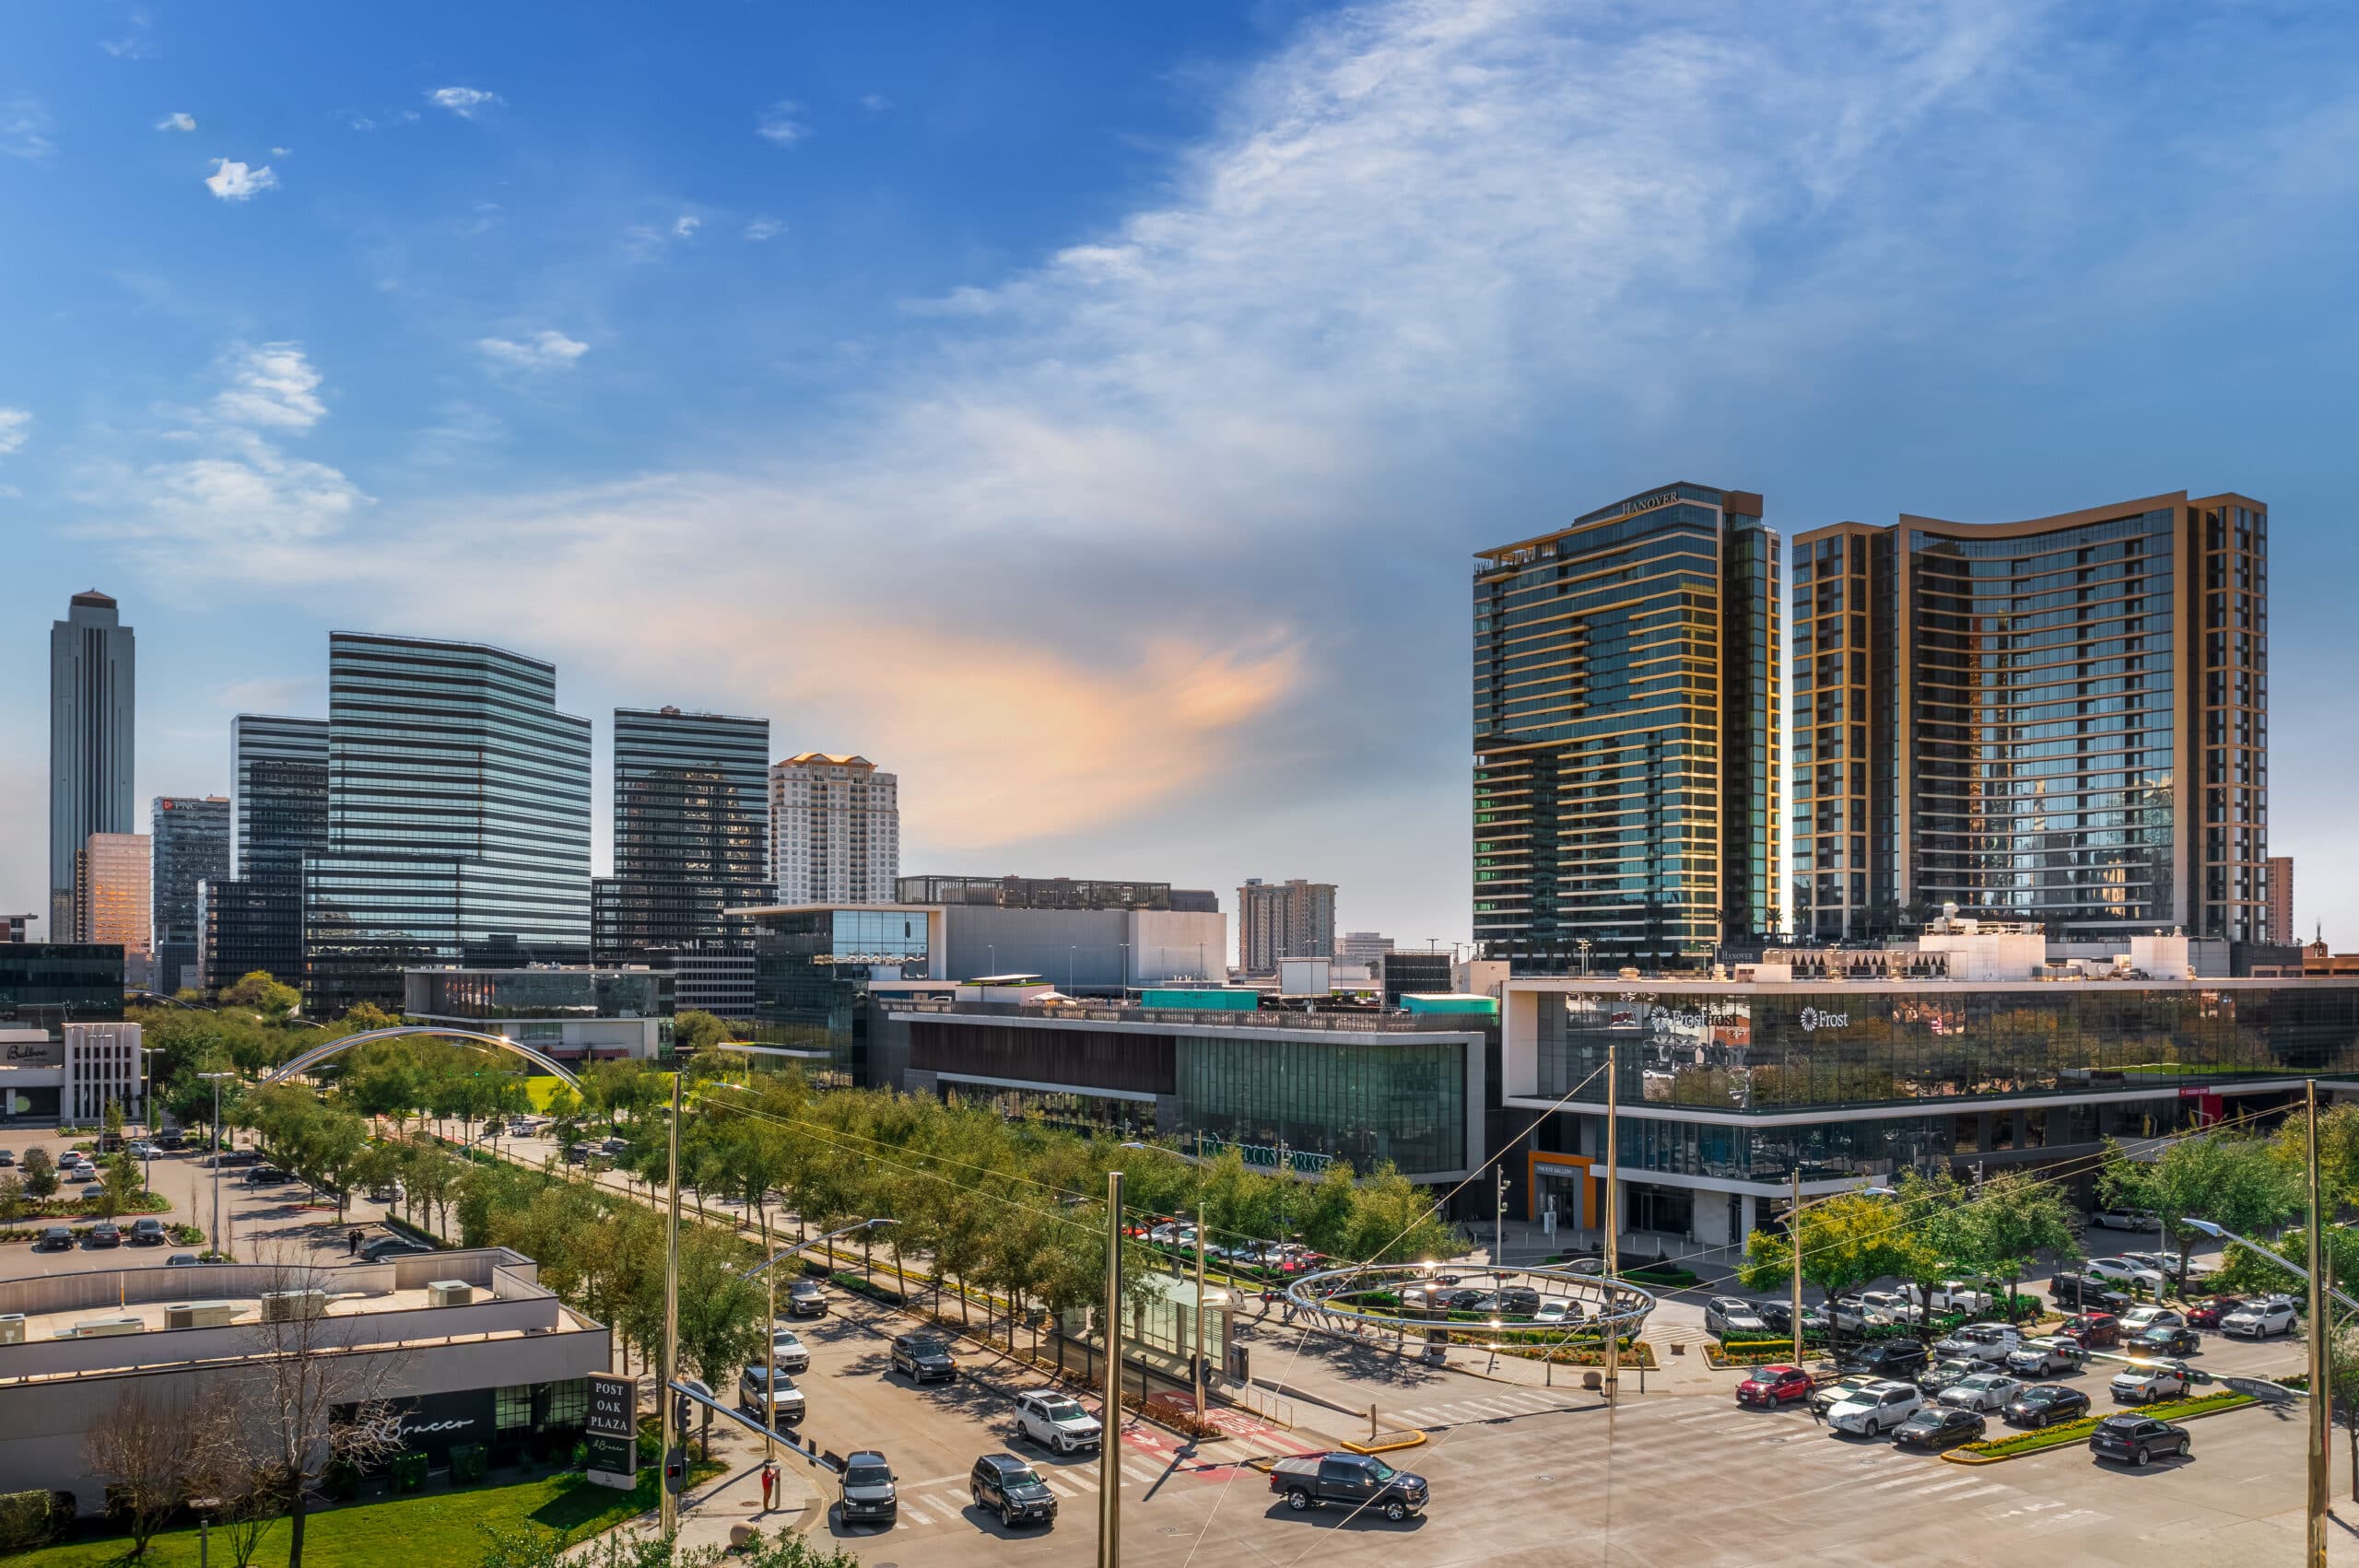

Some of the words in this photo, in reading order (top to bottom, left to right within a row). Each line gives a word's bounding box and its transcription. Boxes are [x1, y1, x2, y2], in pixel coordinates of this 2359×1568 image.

[1622, 491, 1678, 515] HANOVER
[175, 802, 198, 810] PNC
[1721, 950, 1754, 960] HANOVER
[1672, 1010, 1708, 1027] Frost
[1818, 1011, 1848, 1028] Frost
[7, 1045, 48, 1060] Balboa
[1236, 1144, 1277, 1166] OODS
[1278, 1150, 1333, 1174] ARKET
[595, 1382, 624, 1396] POST
[596, 1399, 621, 1413] OAK
[380, 1416, 475, 1442] Bracco
[590, 1415, 628, 1431] PLAZA
